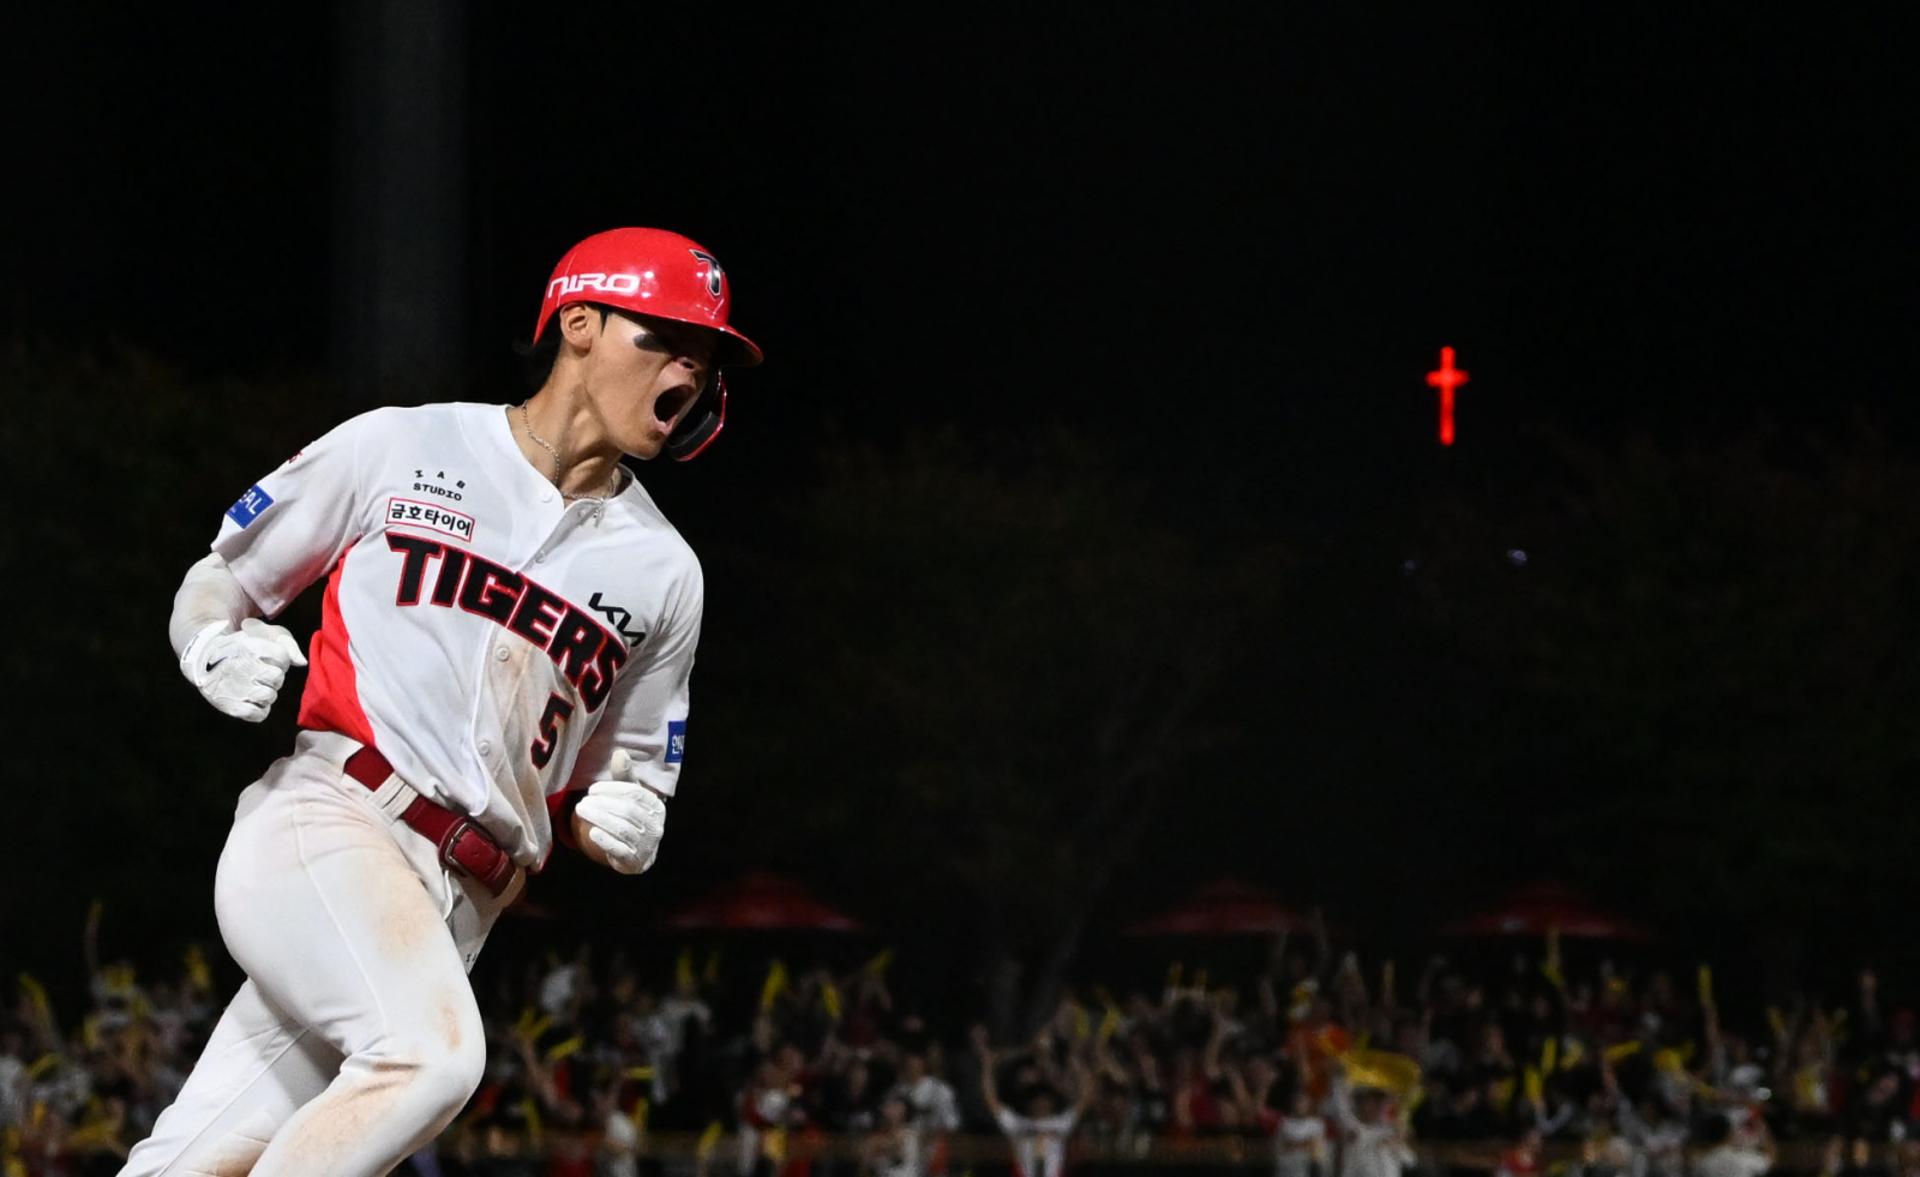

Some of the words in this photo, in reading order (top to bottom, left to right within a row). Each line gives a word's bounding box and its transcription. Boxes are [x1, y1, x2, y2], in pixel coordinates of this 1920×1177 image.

[413, 482, 463, 501] STUDIO
[391, 503, 471, 537] 금호타이어
[385, 532, 628, 714] TIGERS
[530, 691, 575, 770] 5
